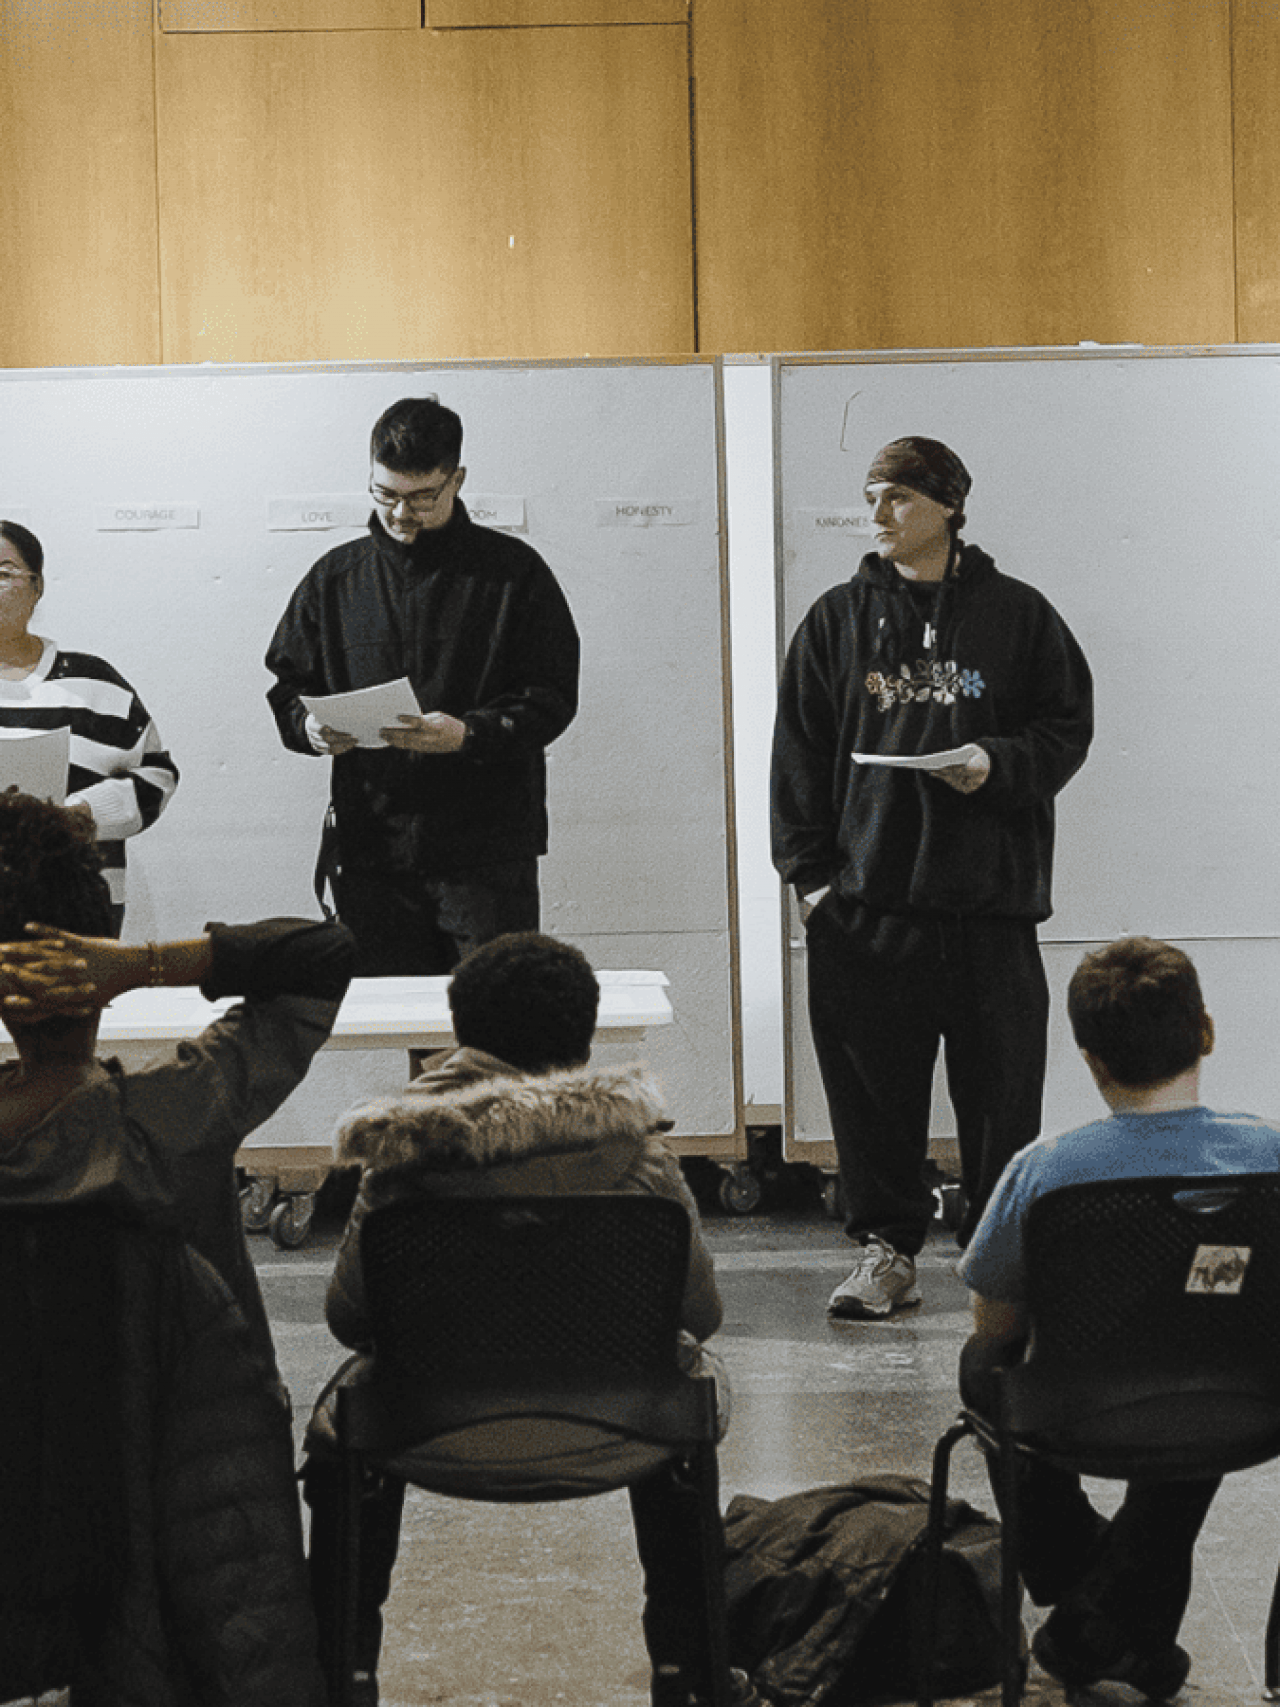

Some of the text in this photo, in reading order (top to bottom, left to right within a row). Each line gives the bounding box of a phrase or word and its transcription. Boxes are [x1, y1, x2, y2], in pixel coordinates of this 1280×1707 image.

[115, 509, 175, 520] COURAGE
[301, 511, 332, 522] LOVE
[615, 506, 672, 516] HONESTY
